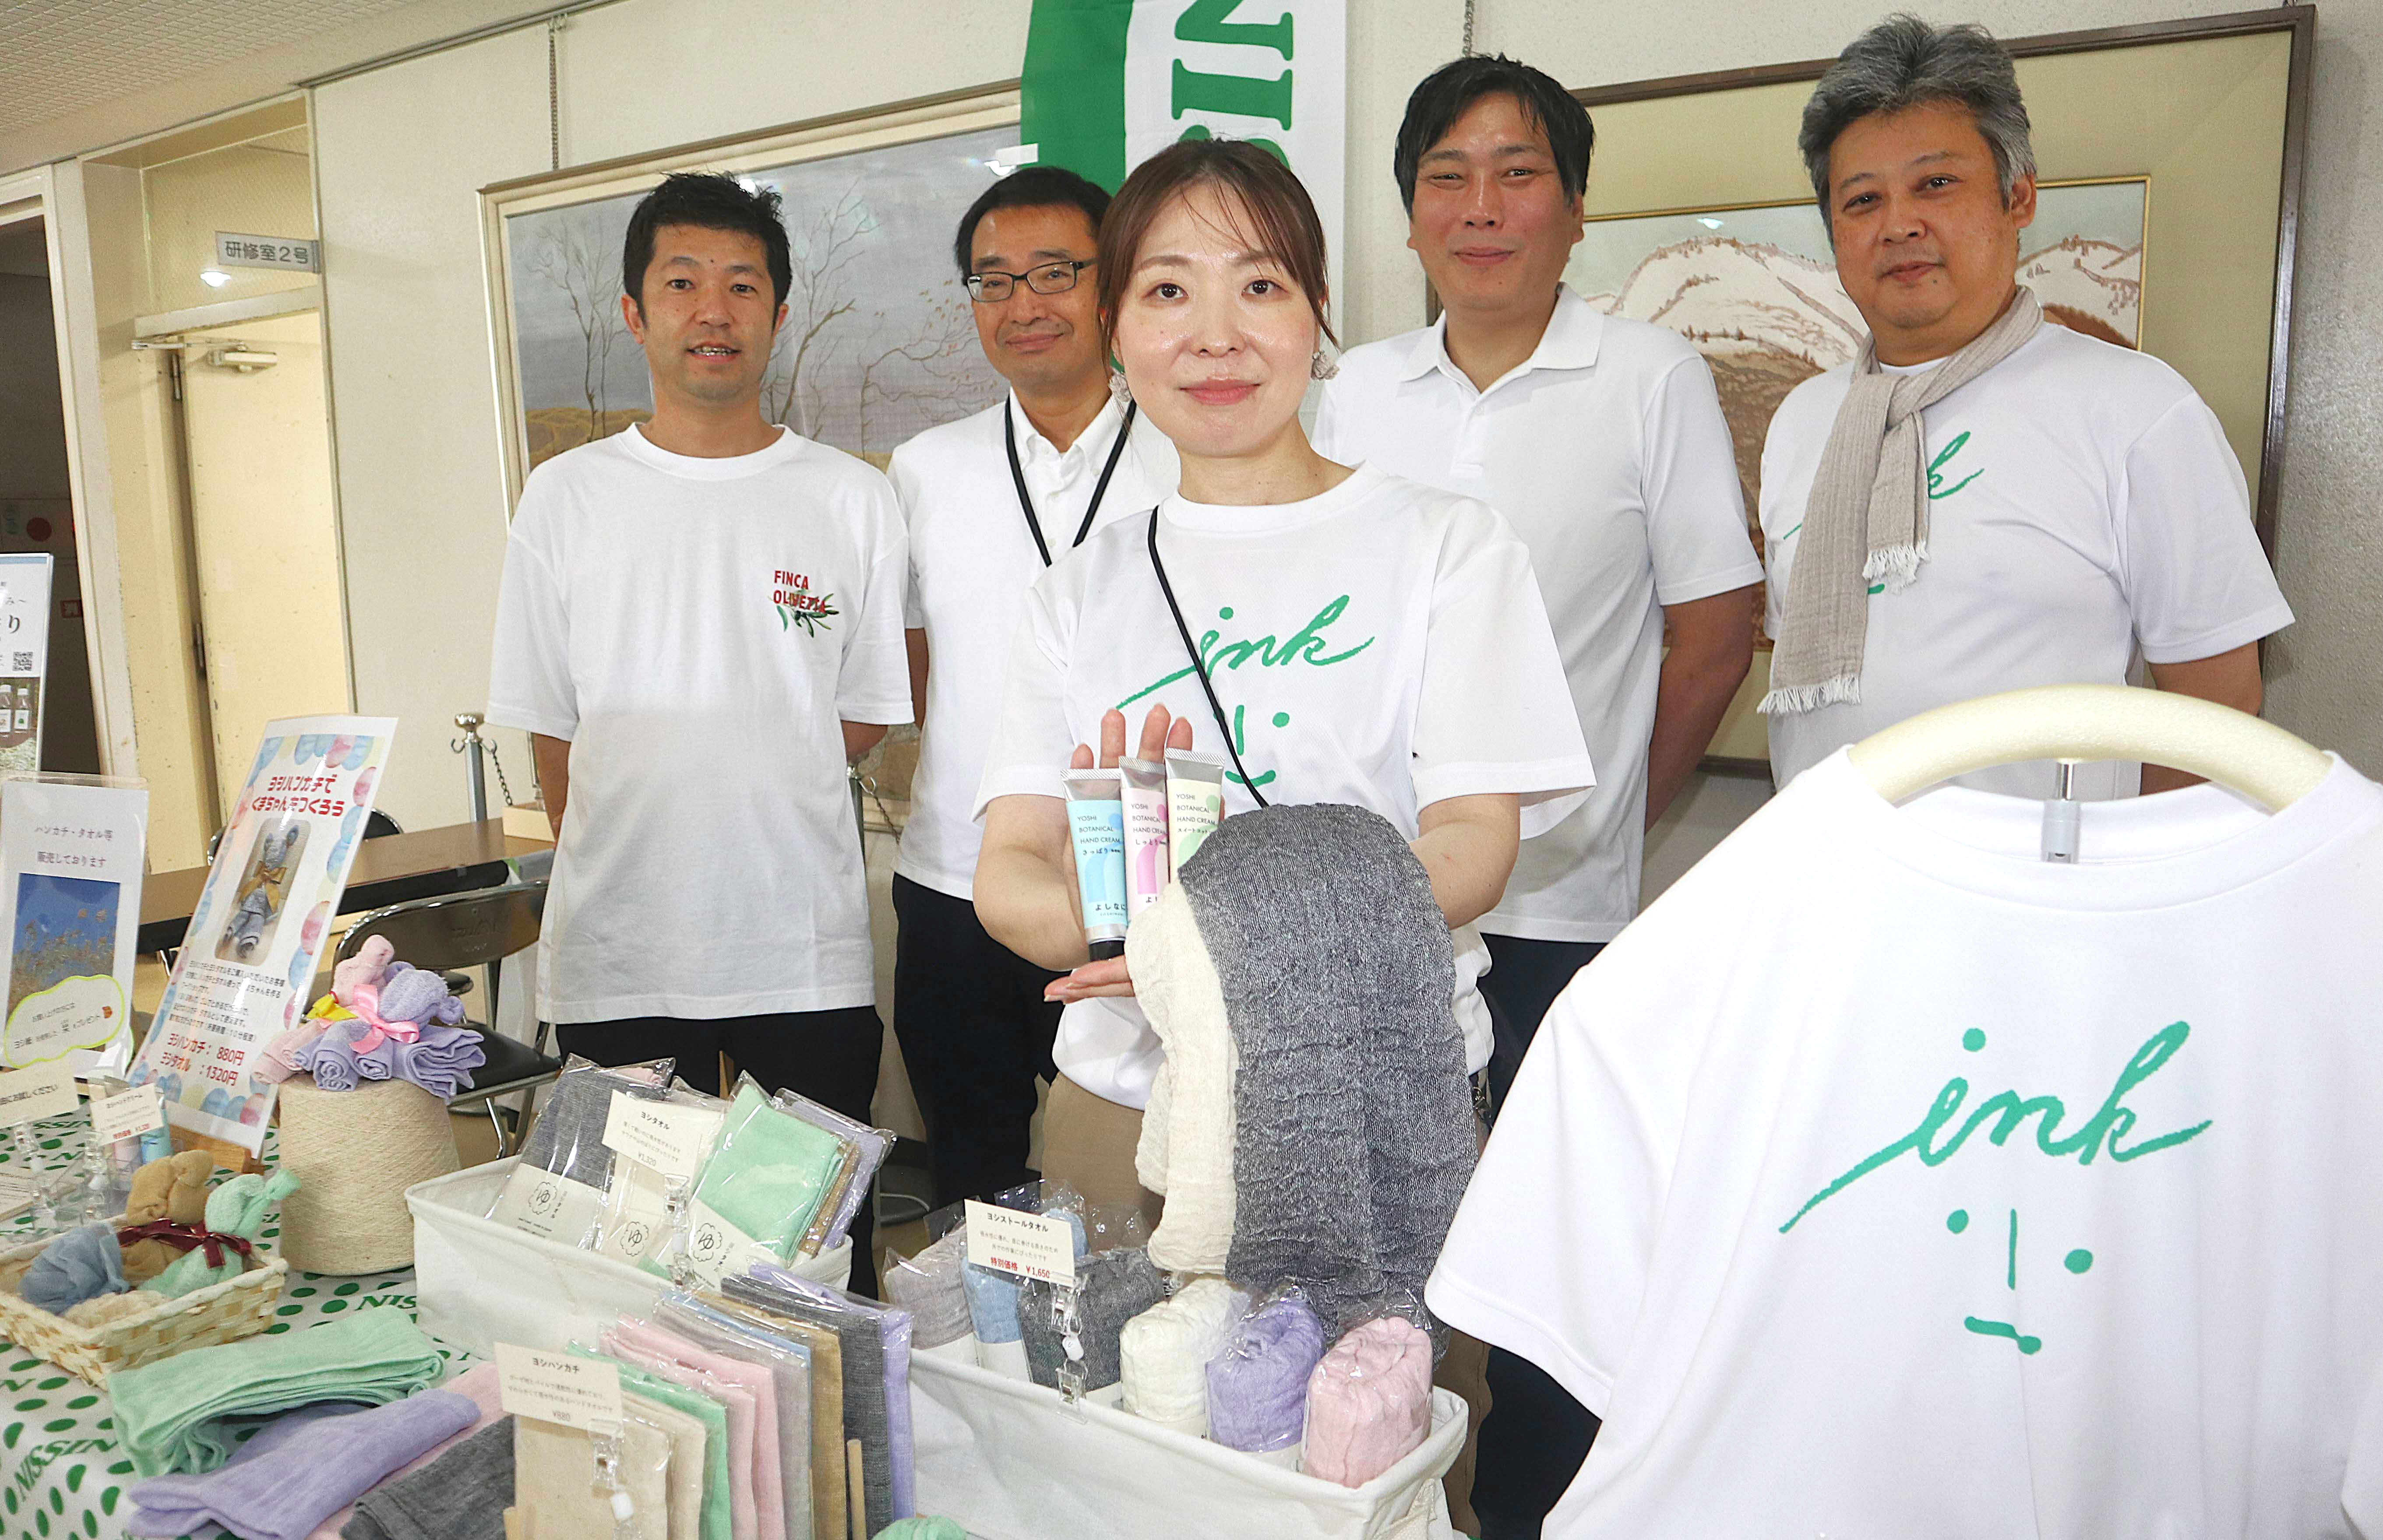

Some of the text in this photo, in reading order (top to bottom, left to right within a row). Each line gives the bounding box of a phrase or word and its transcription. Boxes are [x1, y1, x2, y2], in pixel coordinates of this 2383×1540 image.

[226, 241, 308, 264] 研修室2号
[774, 570, 809, 590] FINCA
[1117, 594, 1375, 710] ink
[268, 774, 337, 793] ヨシハンカチで
[252, 796, 345, 817] くまちゃんをつくろう
[1177, 805, 1209, 813] BOTANICAL
[1197, 817, 1215, 826] CREAM
[37, 851, 106, 867] 販売しております
[217, 1047, 245, 1066] 880円
[641, 1111, 670, 1129] ヨシタオル
[1779, 1021, 2213, 1233] ink
[987, 1212, 1048, 1232] ヨシストールタオル
[991, 1257, 1018, 1271] 特別価格
[532, 1357, 580, 1374] ヨシハンカチ
[14, 1439, 118, 1502] NISSIN
